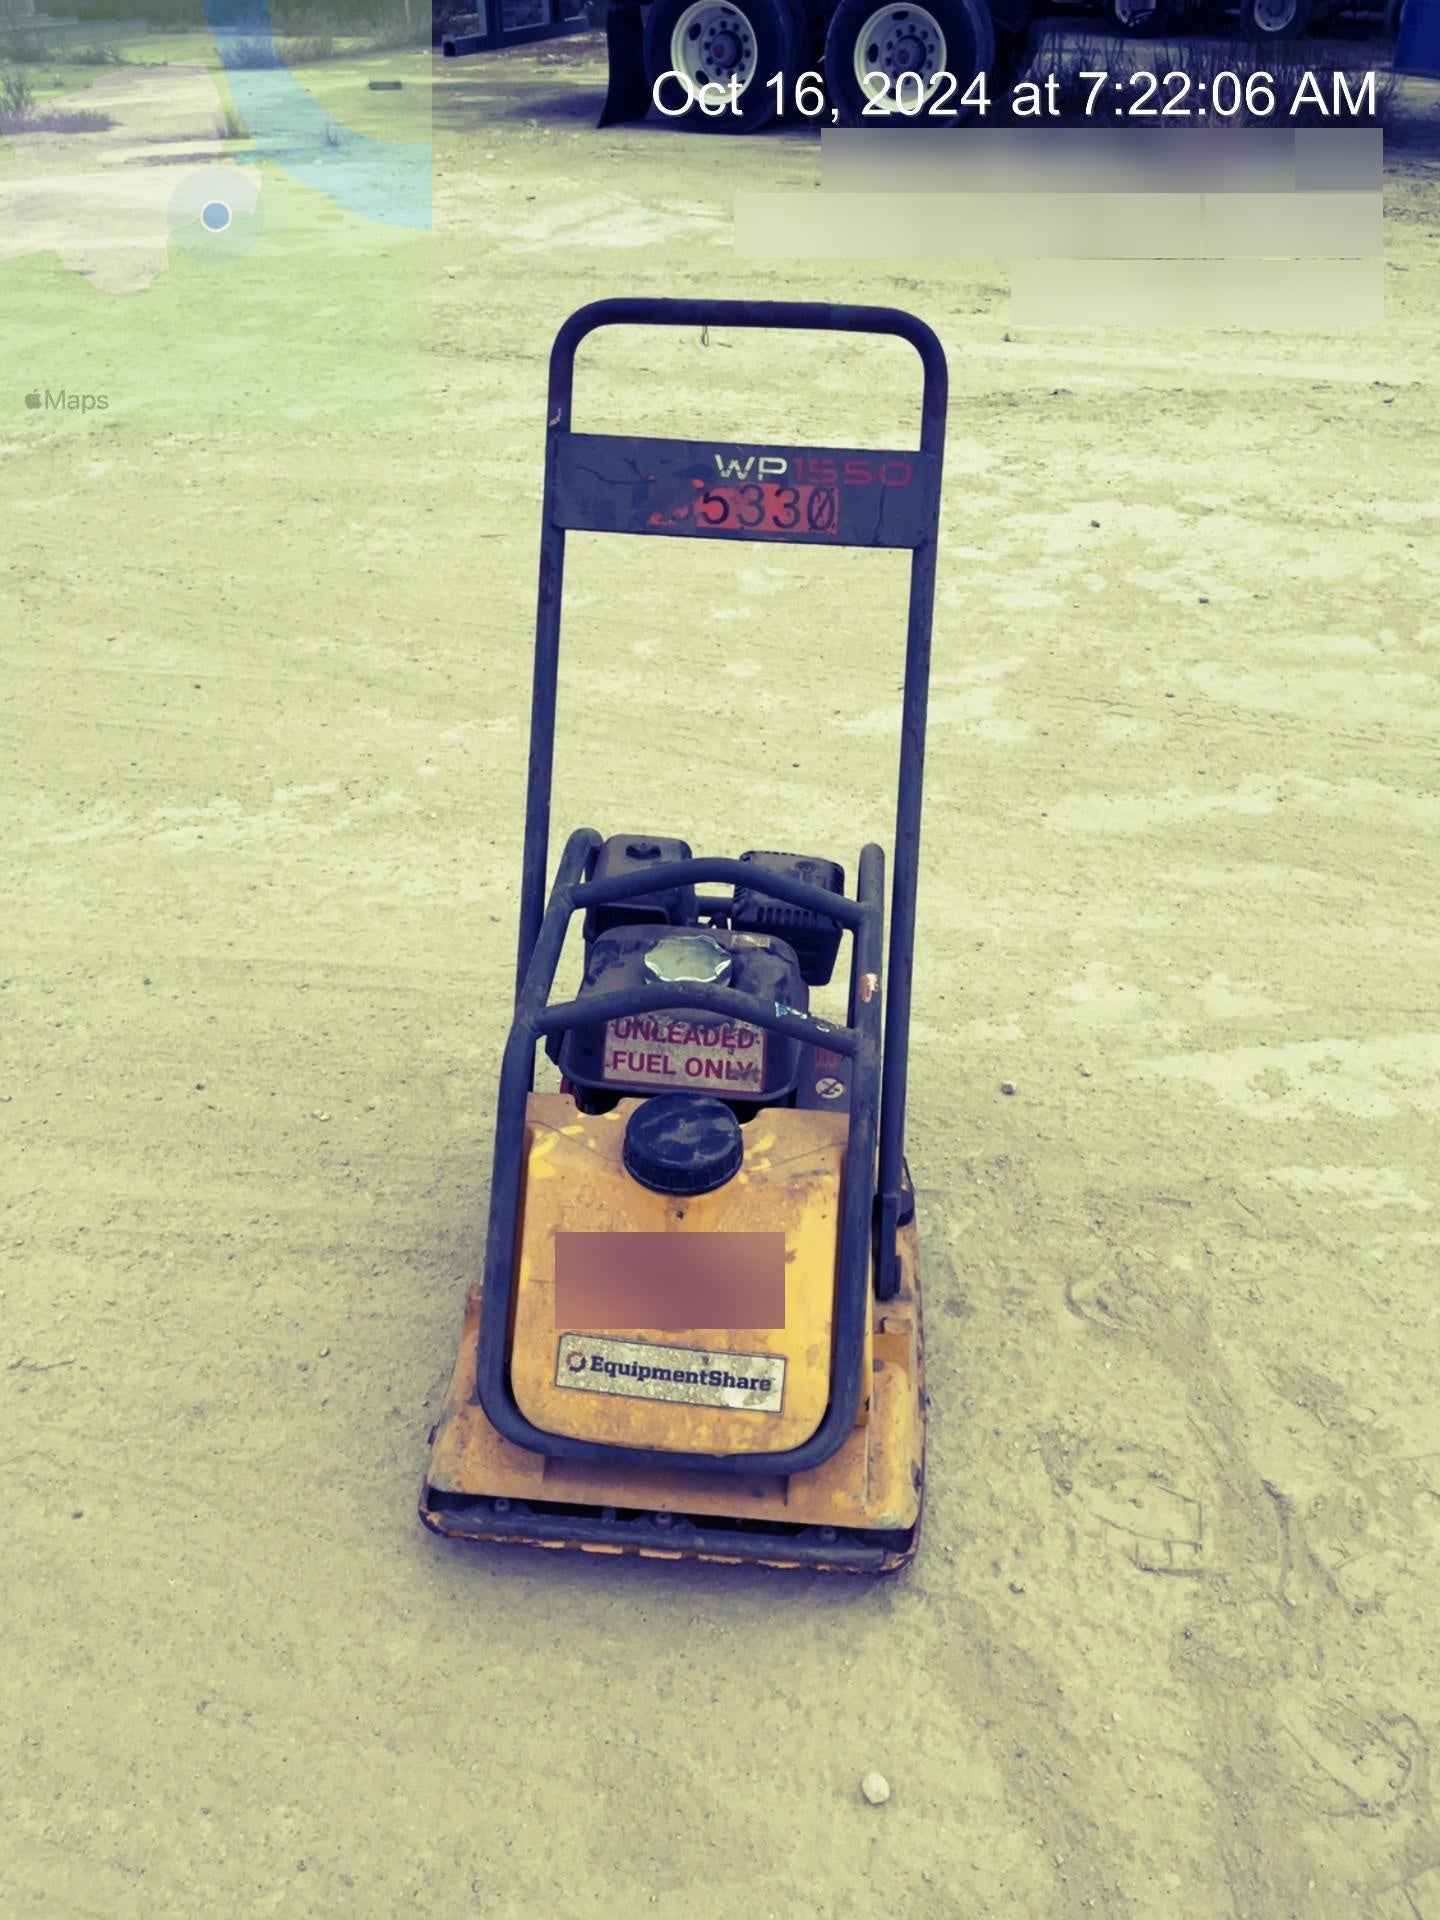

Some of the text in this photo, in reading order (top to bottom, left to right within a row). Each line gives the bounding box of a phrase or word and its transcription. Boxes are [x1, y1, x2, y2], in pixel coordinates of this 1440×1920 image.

[613, 1015, 755, 1049] UNLEADED
[612, 1050, 754, 1081] FUEL ONLY
[590, 1355, 772, 1392] EquipmentShare
